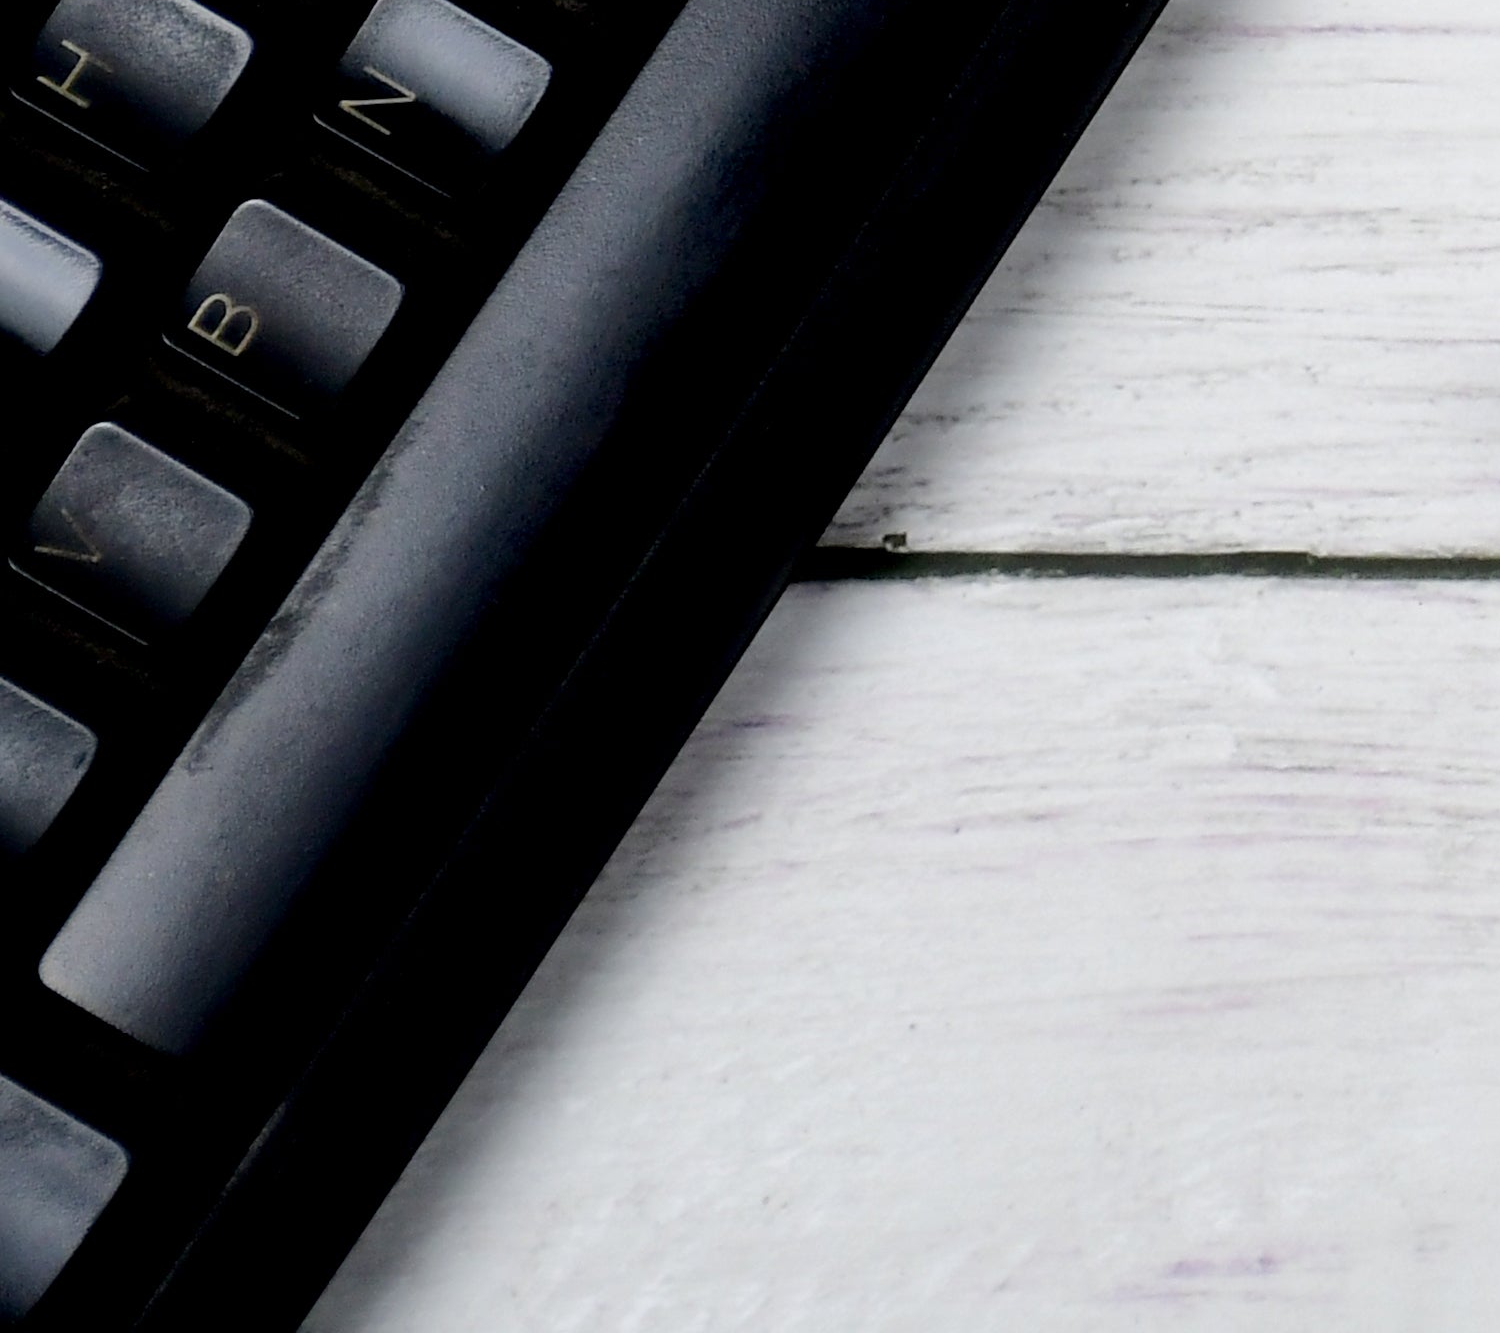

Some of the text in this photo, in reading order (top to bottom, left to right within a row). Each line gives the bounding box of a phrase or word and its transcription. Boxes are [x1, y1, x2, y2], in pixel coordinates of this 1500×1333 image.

[36, 39, 114, 110] H
[338, 66, 418, 136] N
[186, 290, 261, 358] B
[33, 507, 104, 565] V
